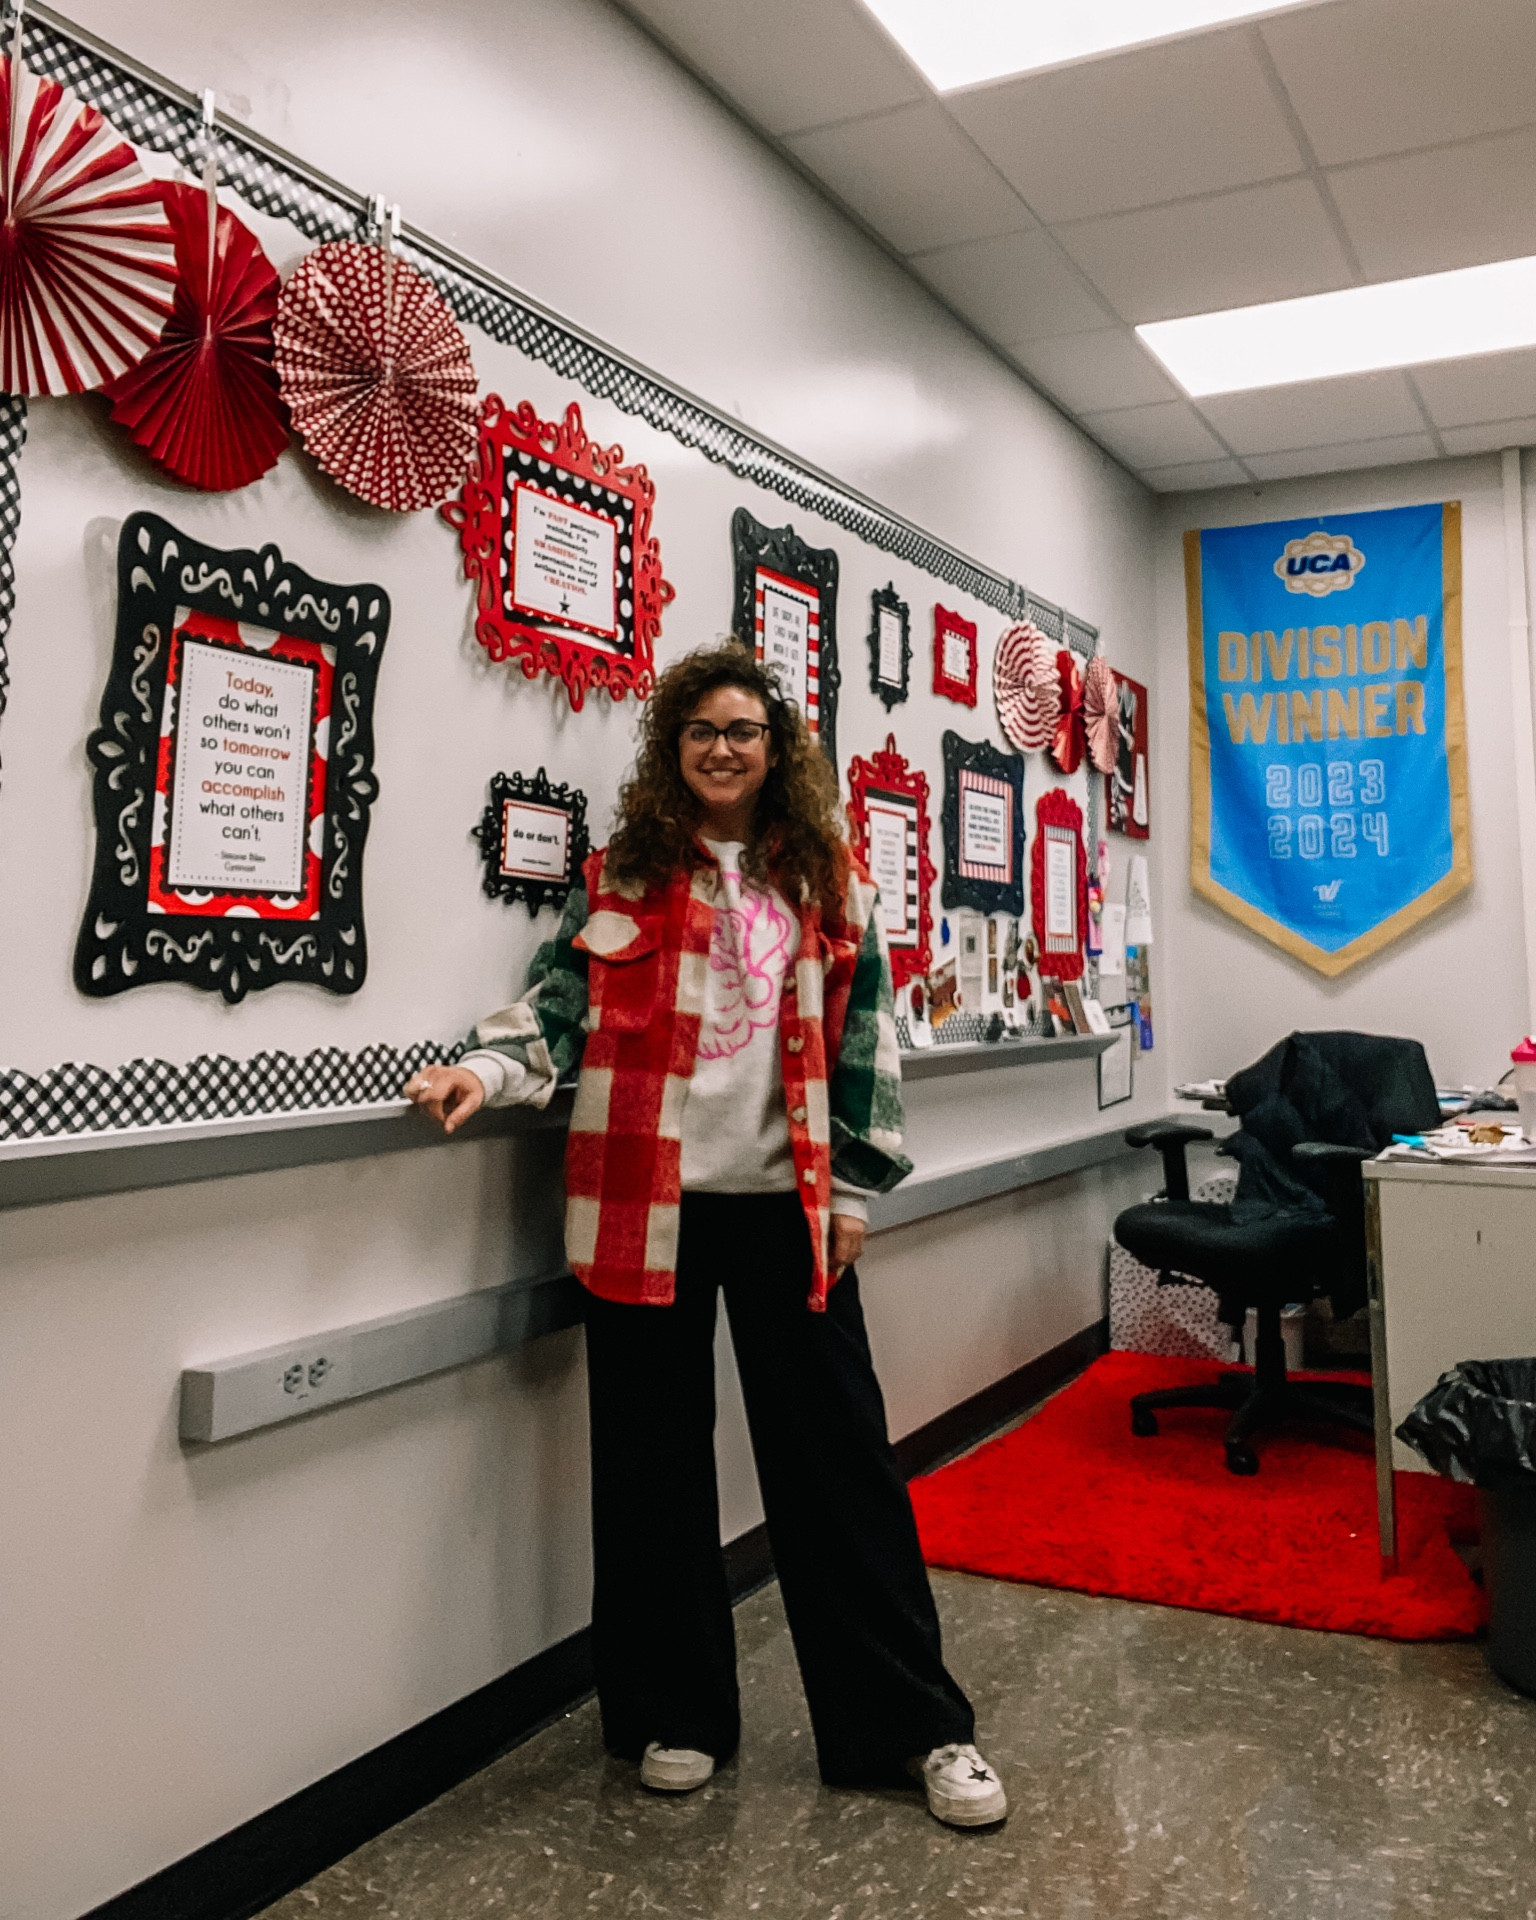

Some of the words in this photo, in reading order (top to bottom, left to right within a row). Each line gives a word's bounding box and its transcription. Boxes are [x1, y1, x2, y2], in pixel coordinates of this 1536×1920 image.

[1286, 552, 1353, 576] UCA
[1217, 615, 1428, 683] DIVISION
[226, 671, 274, 698] Today,
[219, 694, 240, 711] do
[244, 699, 278, 717] what
[1222, 680, 1426, 744] WINNER
[202, 714, 249, 734] others
[254, 722, 290, 740] won't
[200, 737, 218, 750] so
[223, 738, 291, 761] tomorrow
[214, 760, 242, 775] you
[247, 765, 275, 779] can
[201, 780, 285, 802] accomplish
[1266, 758, 1387, 809] 2023
[199, 801, 235, 817] what
[240, 805, 284, 822] others
[222, 824, 262, 842] can't.
[513, 828, 524, 838] do
[526, 832, 535, 840] or
[1267, 811, 1389, 860] 2024
